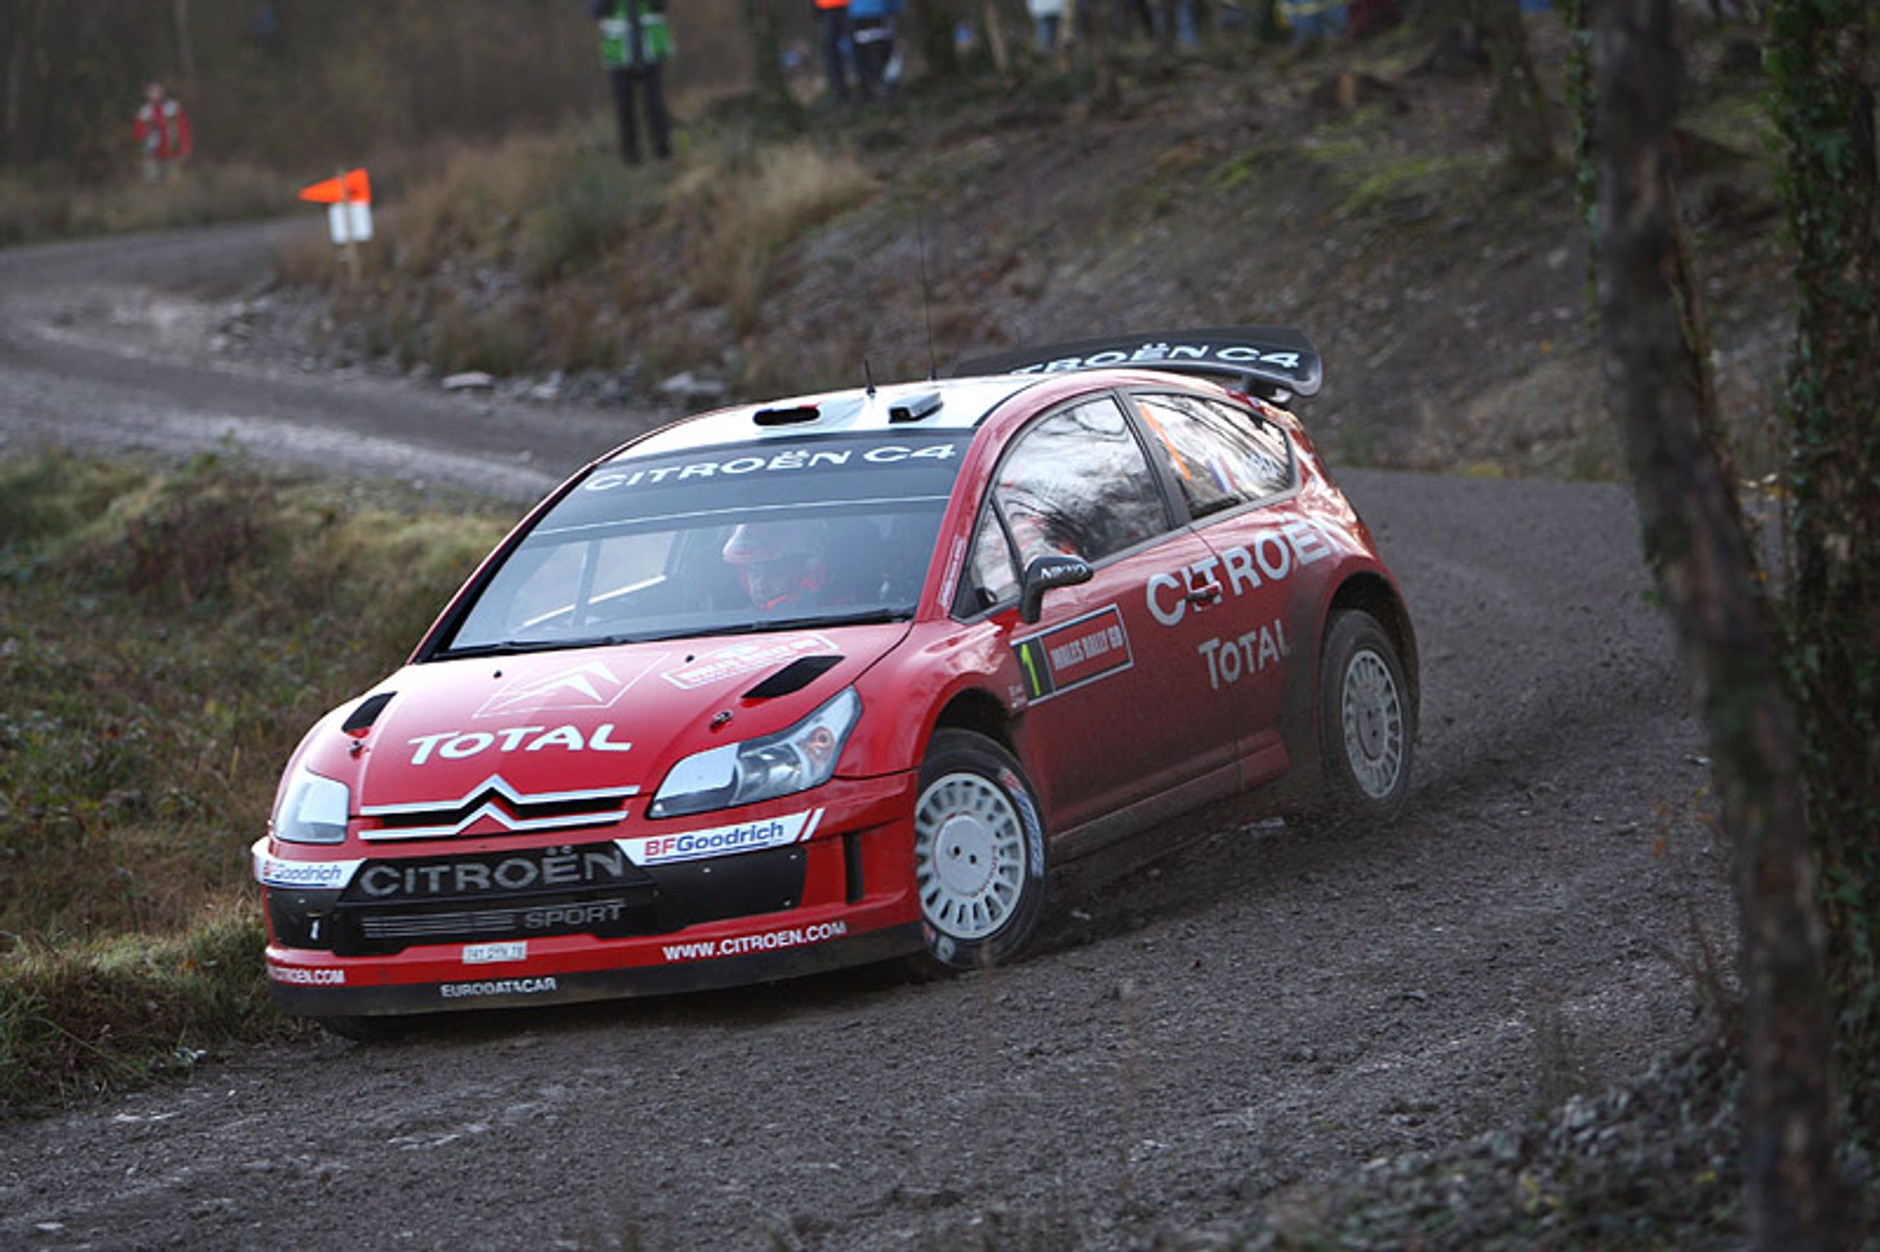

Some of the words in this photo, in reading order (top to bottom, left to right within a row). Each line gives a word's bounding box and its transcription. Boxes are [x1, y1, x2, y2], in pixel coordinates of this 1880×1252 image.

[1010, 342, 1209, 375] TROËN
[1217, 347, 1299, 369] C4
[585, 449, 852, 491] CITROËN
[864, 444, 956, 462] C4
[1020, 643, 1042, 697] 1
[1197, 619, 1291, 691] TOTAL
[407, 724, 633, 765] TOTAL
[644, 821, 784, 857] BFGoodrich
[359, 844, 624, 897] CITROËN
[525, 902, 626, 930] SPORT
[662, 921, 848, 961] WWW.CITROEN.COM
